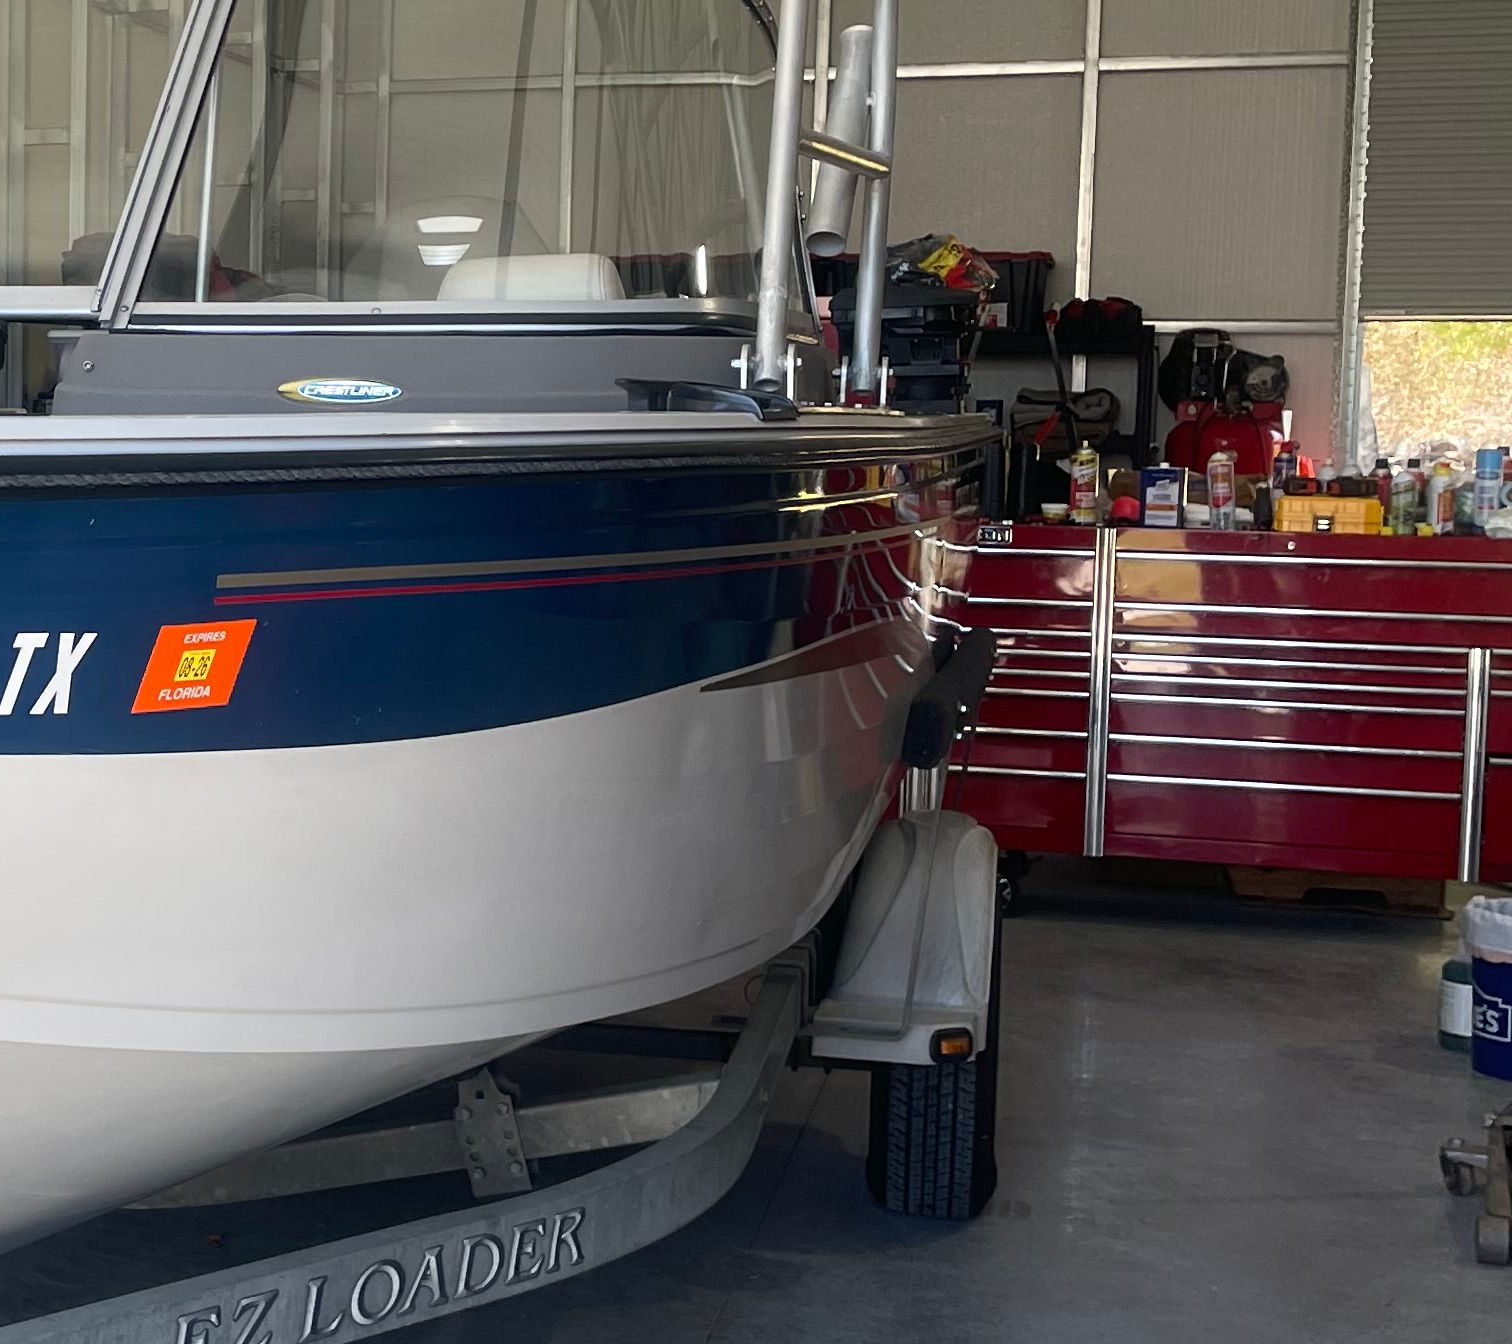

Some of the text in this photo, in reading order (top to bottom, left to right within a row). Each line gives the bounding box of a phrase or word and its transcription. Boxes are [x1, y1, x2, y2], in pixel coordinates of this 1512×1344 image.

[304, 384, 395, 398] CRESTLINER
[183, 630, 227, 645] EXPIRES
[157, 685, 211, 702] FLORIDA
